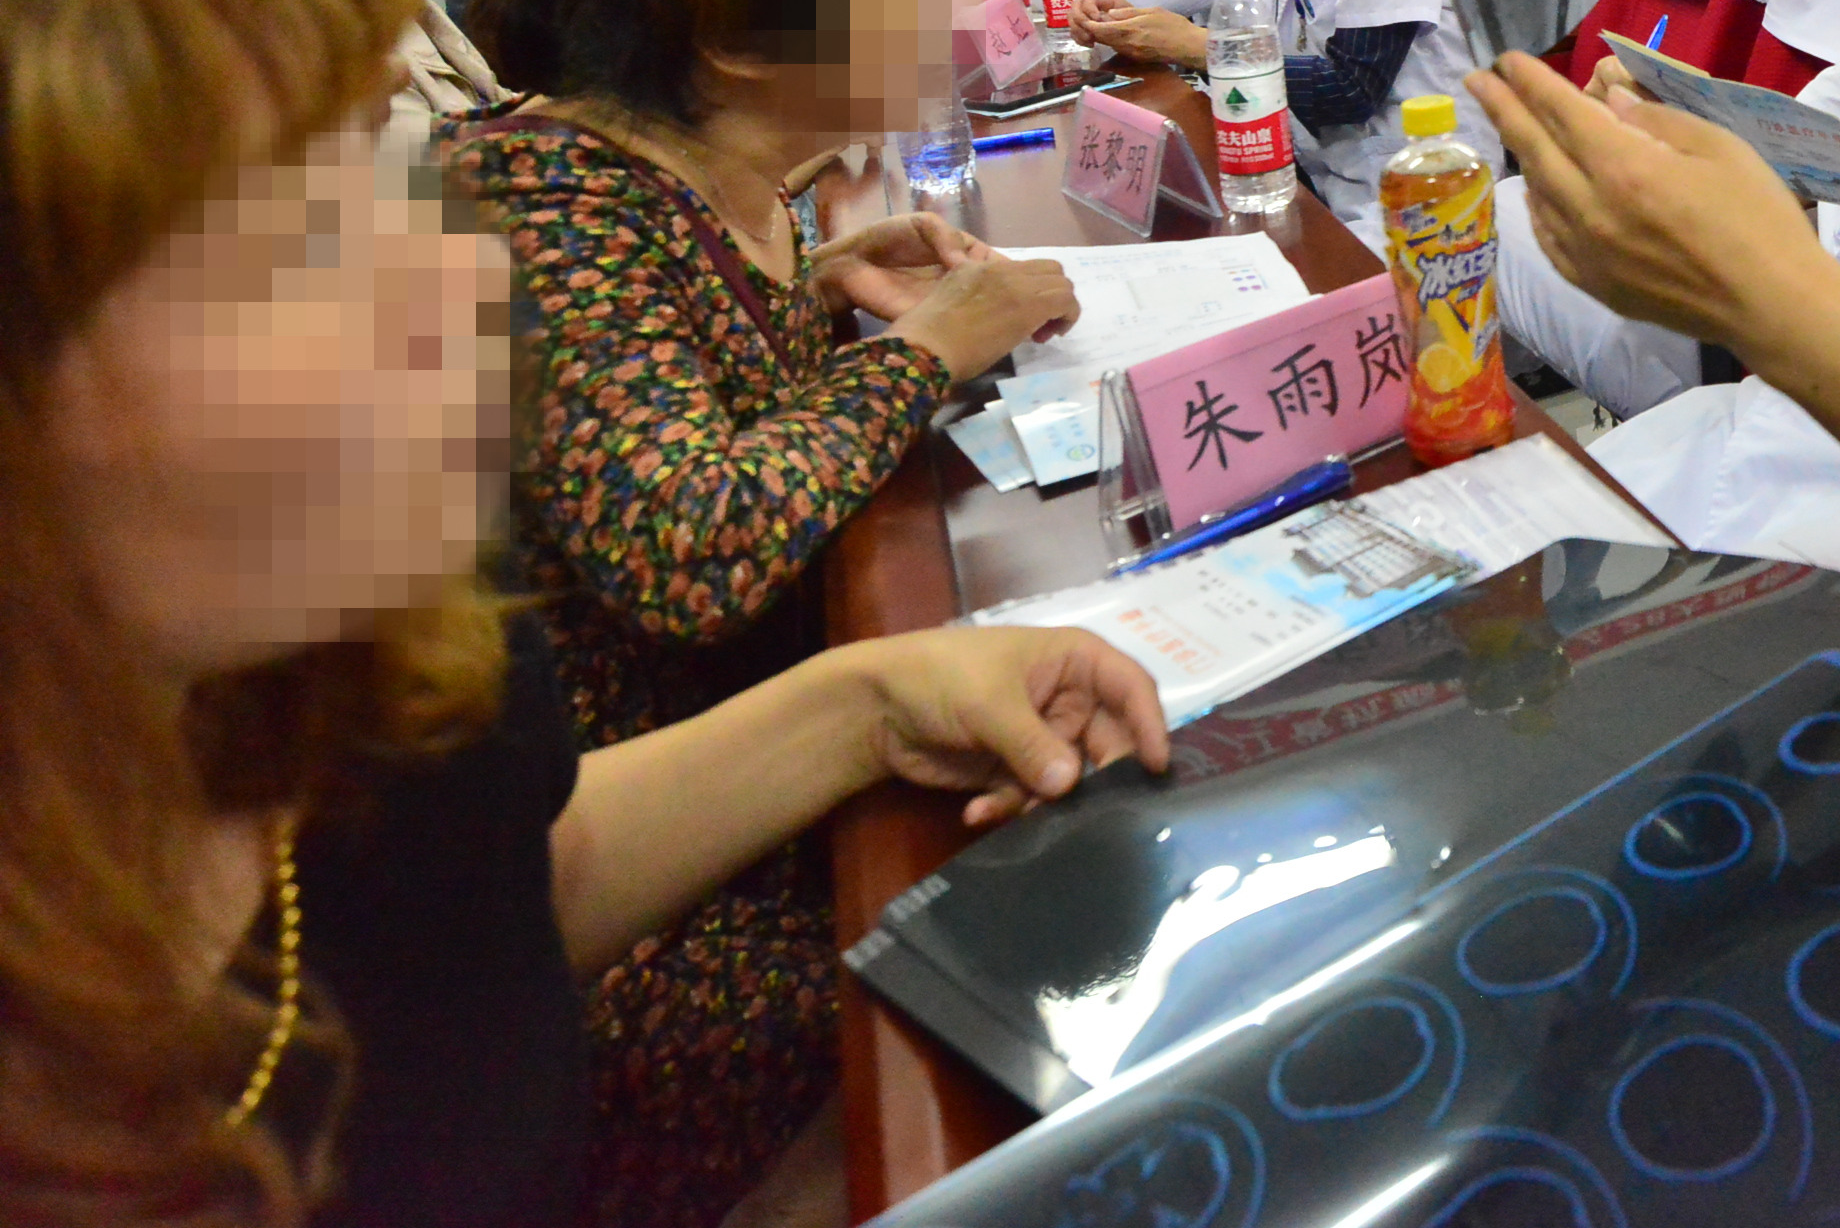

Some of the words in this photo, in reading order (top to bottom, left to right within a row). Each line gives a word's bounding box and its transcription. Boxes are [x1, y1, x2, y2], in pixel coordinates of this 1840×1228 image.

[1216, 127, 1273, 146] 农夫山泉
[1182, 312, 1408, 471] 朱雨岚
